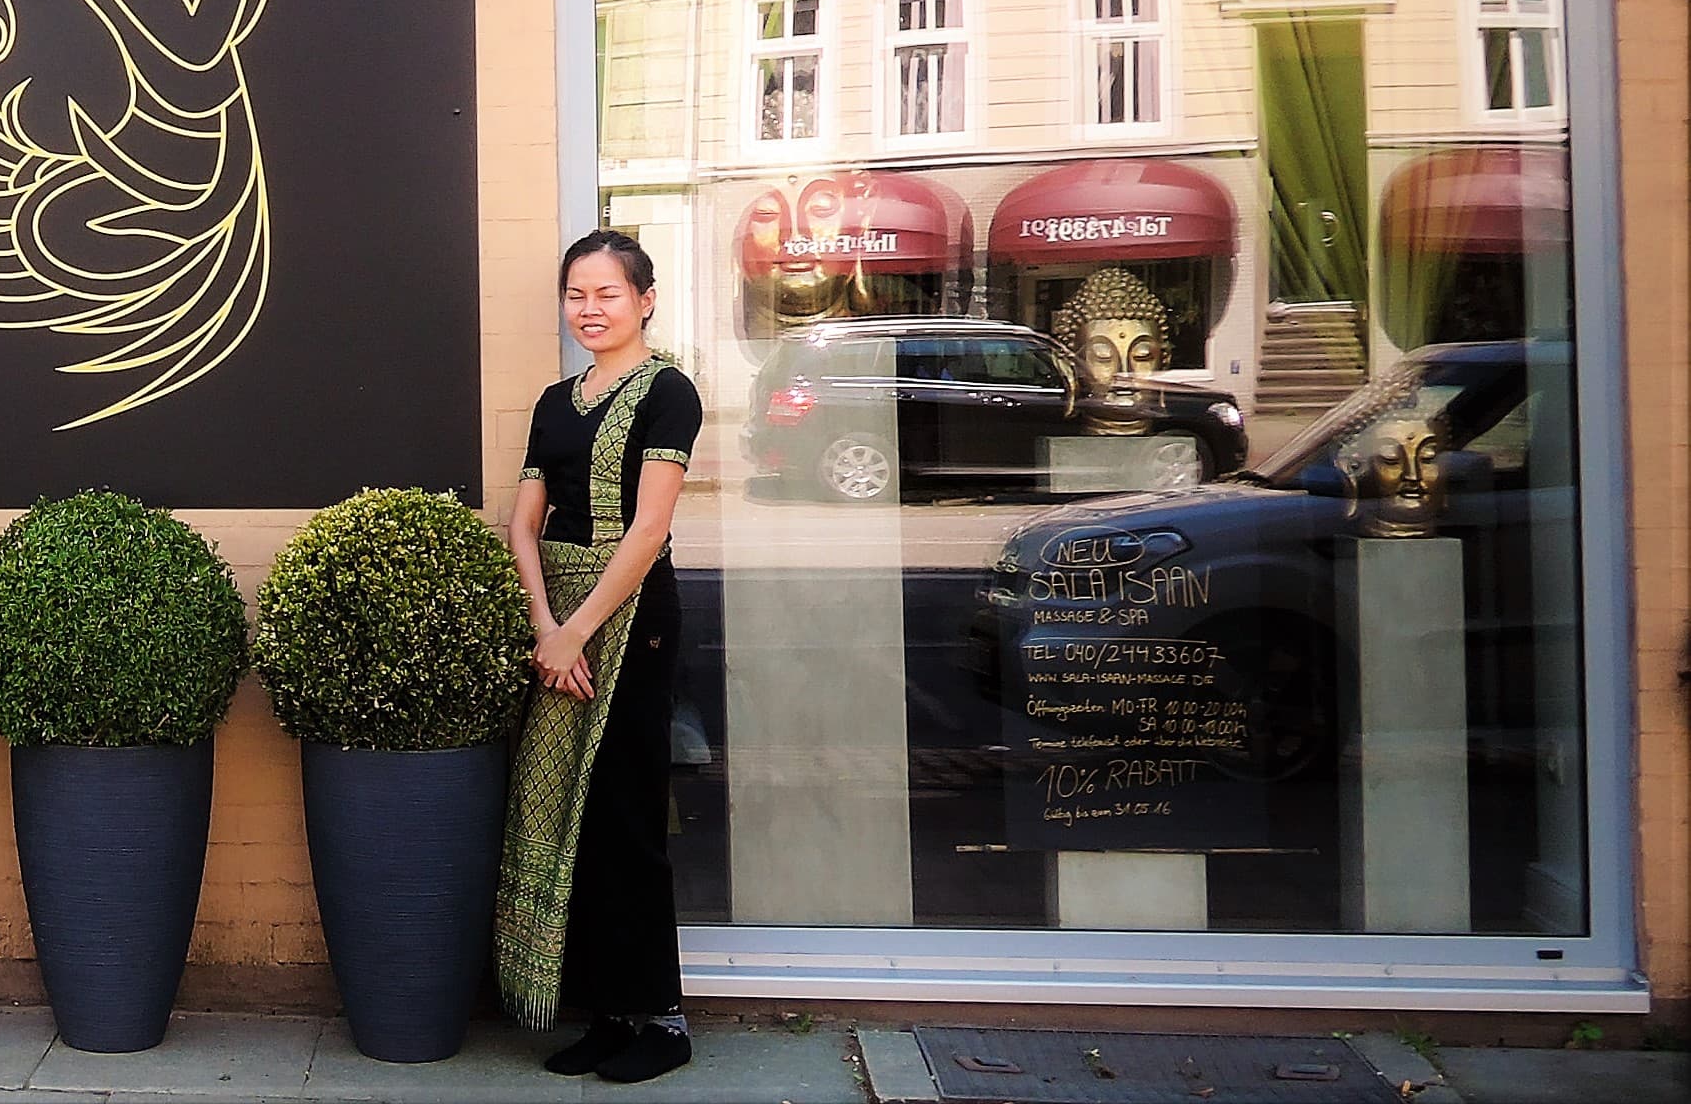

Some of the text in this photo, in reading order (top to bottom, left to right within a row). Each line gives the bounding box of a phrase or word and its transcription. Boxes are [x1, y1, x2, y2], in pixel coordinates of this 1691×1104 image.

[1056, 539, 1117, 563] NEU
[1029, 565, 1211, 608] SALA ISAAN
[1034, 607, 1150, 626] MASSAGE & SPA
[1064, 642, 1226, 669] 040/24433607
[1138, 716, 1157, 733] SA
[1035, 759, 1211, 803] 10% RABATT
